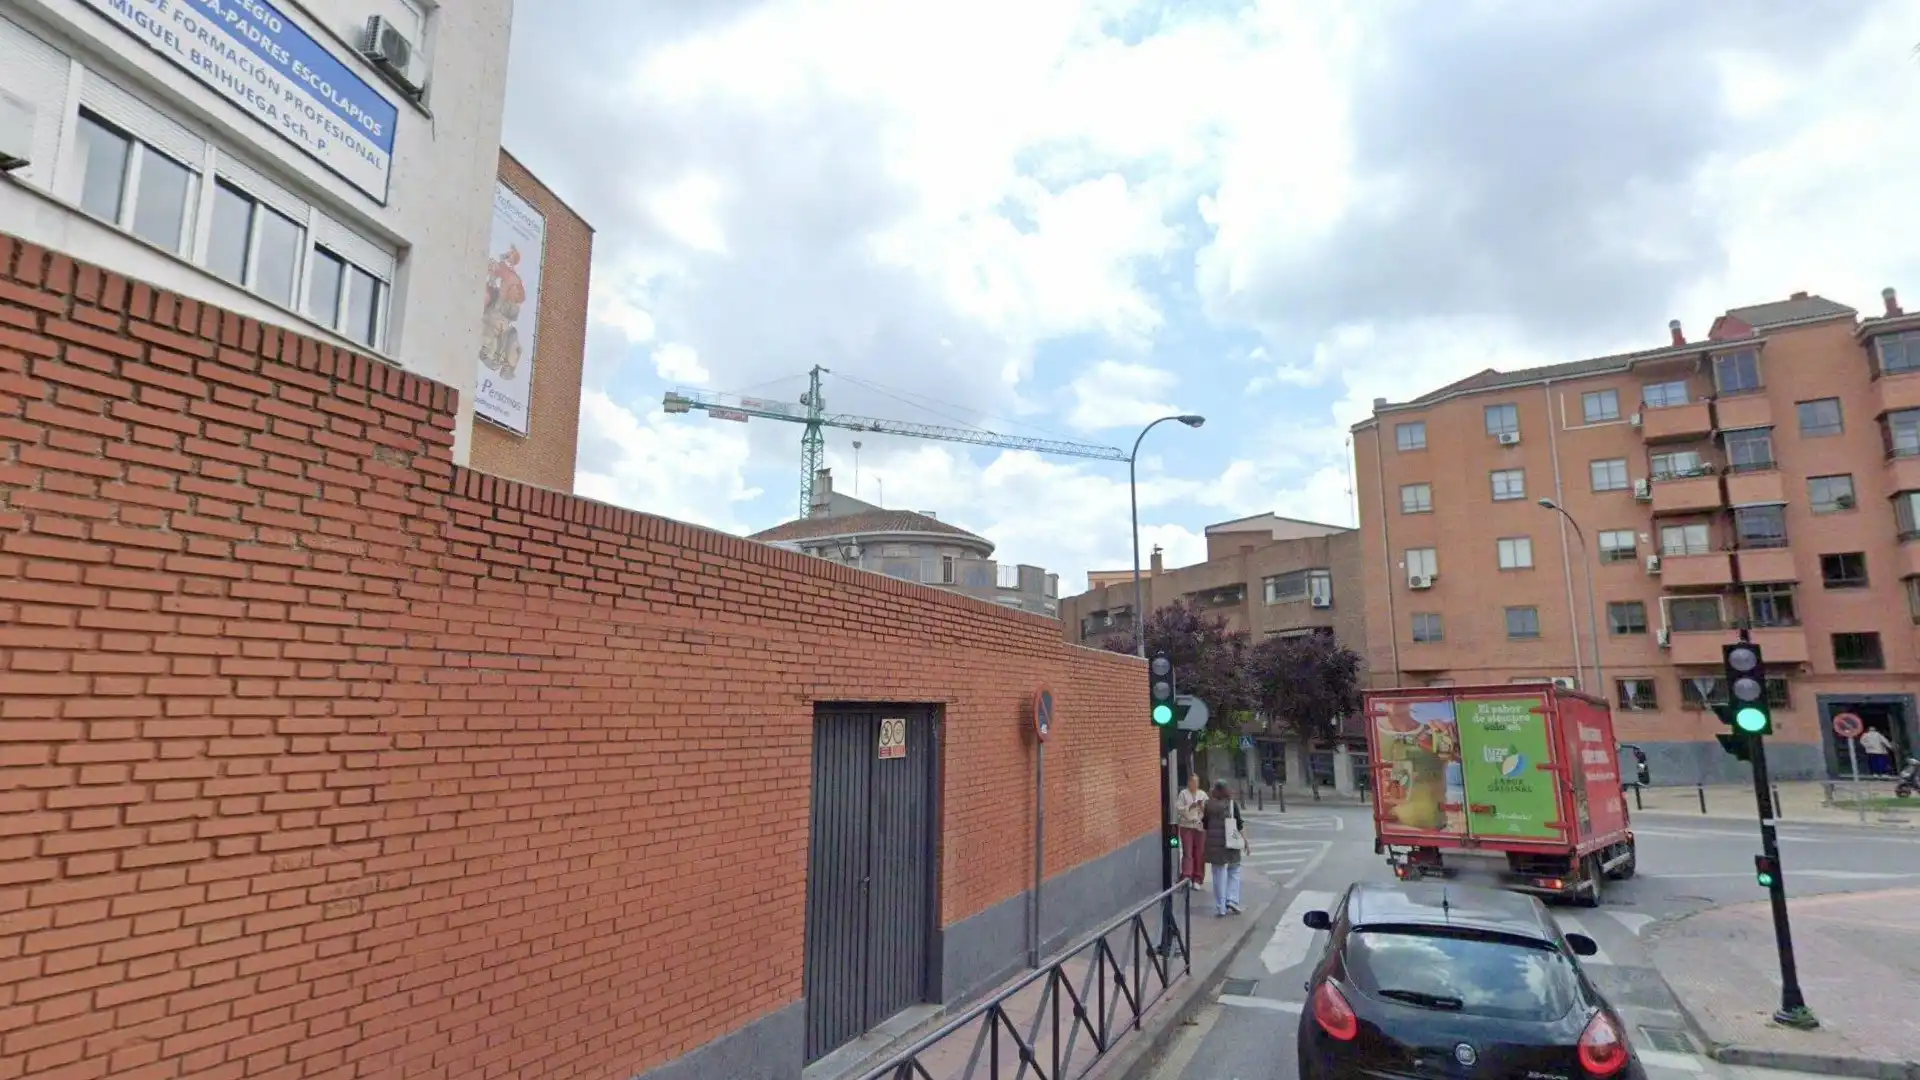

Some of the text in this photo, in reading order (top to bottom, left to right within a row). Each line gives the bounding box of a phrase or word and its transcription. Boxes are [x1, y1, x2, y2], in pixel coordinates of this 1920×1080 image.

[109, 0, 185, 56] MIGUEL
[190, 48, 277, 120] BRIHUEGA
[202, 0, 383, 137] A-PADRES ESCOLAPIOS
[235, 0, 282, 33] EGIO
[173, 8, 280, 95] FORMACIÓN
[284, 89, 382, 170] PROFESIONAL
